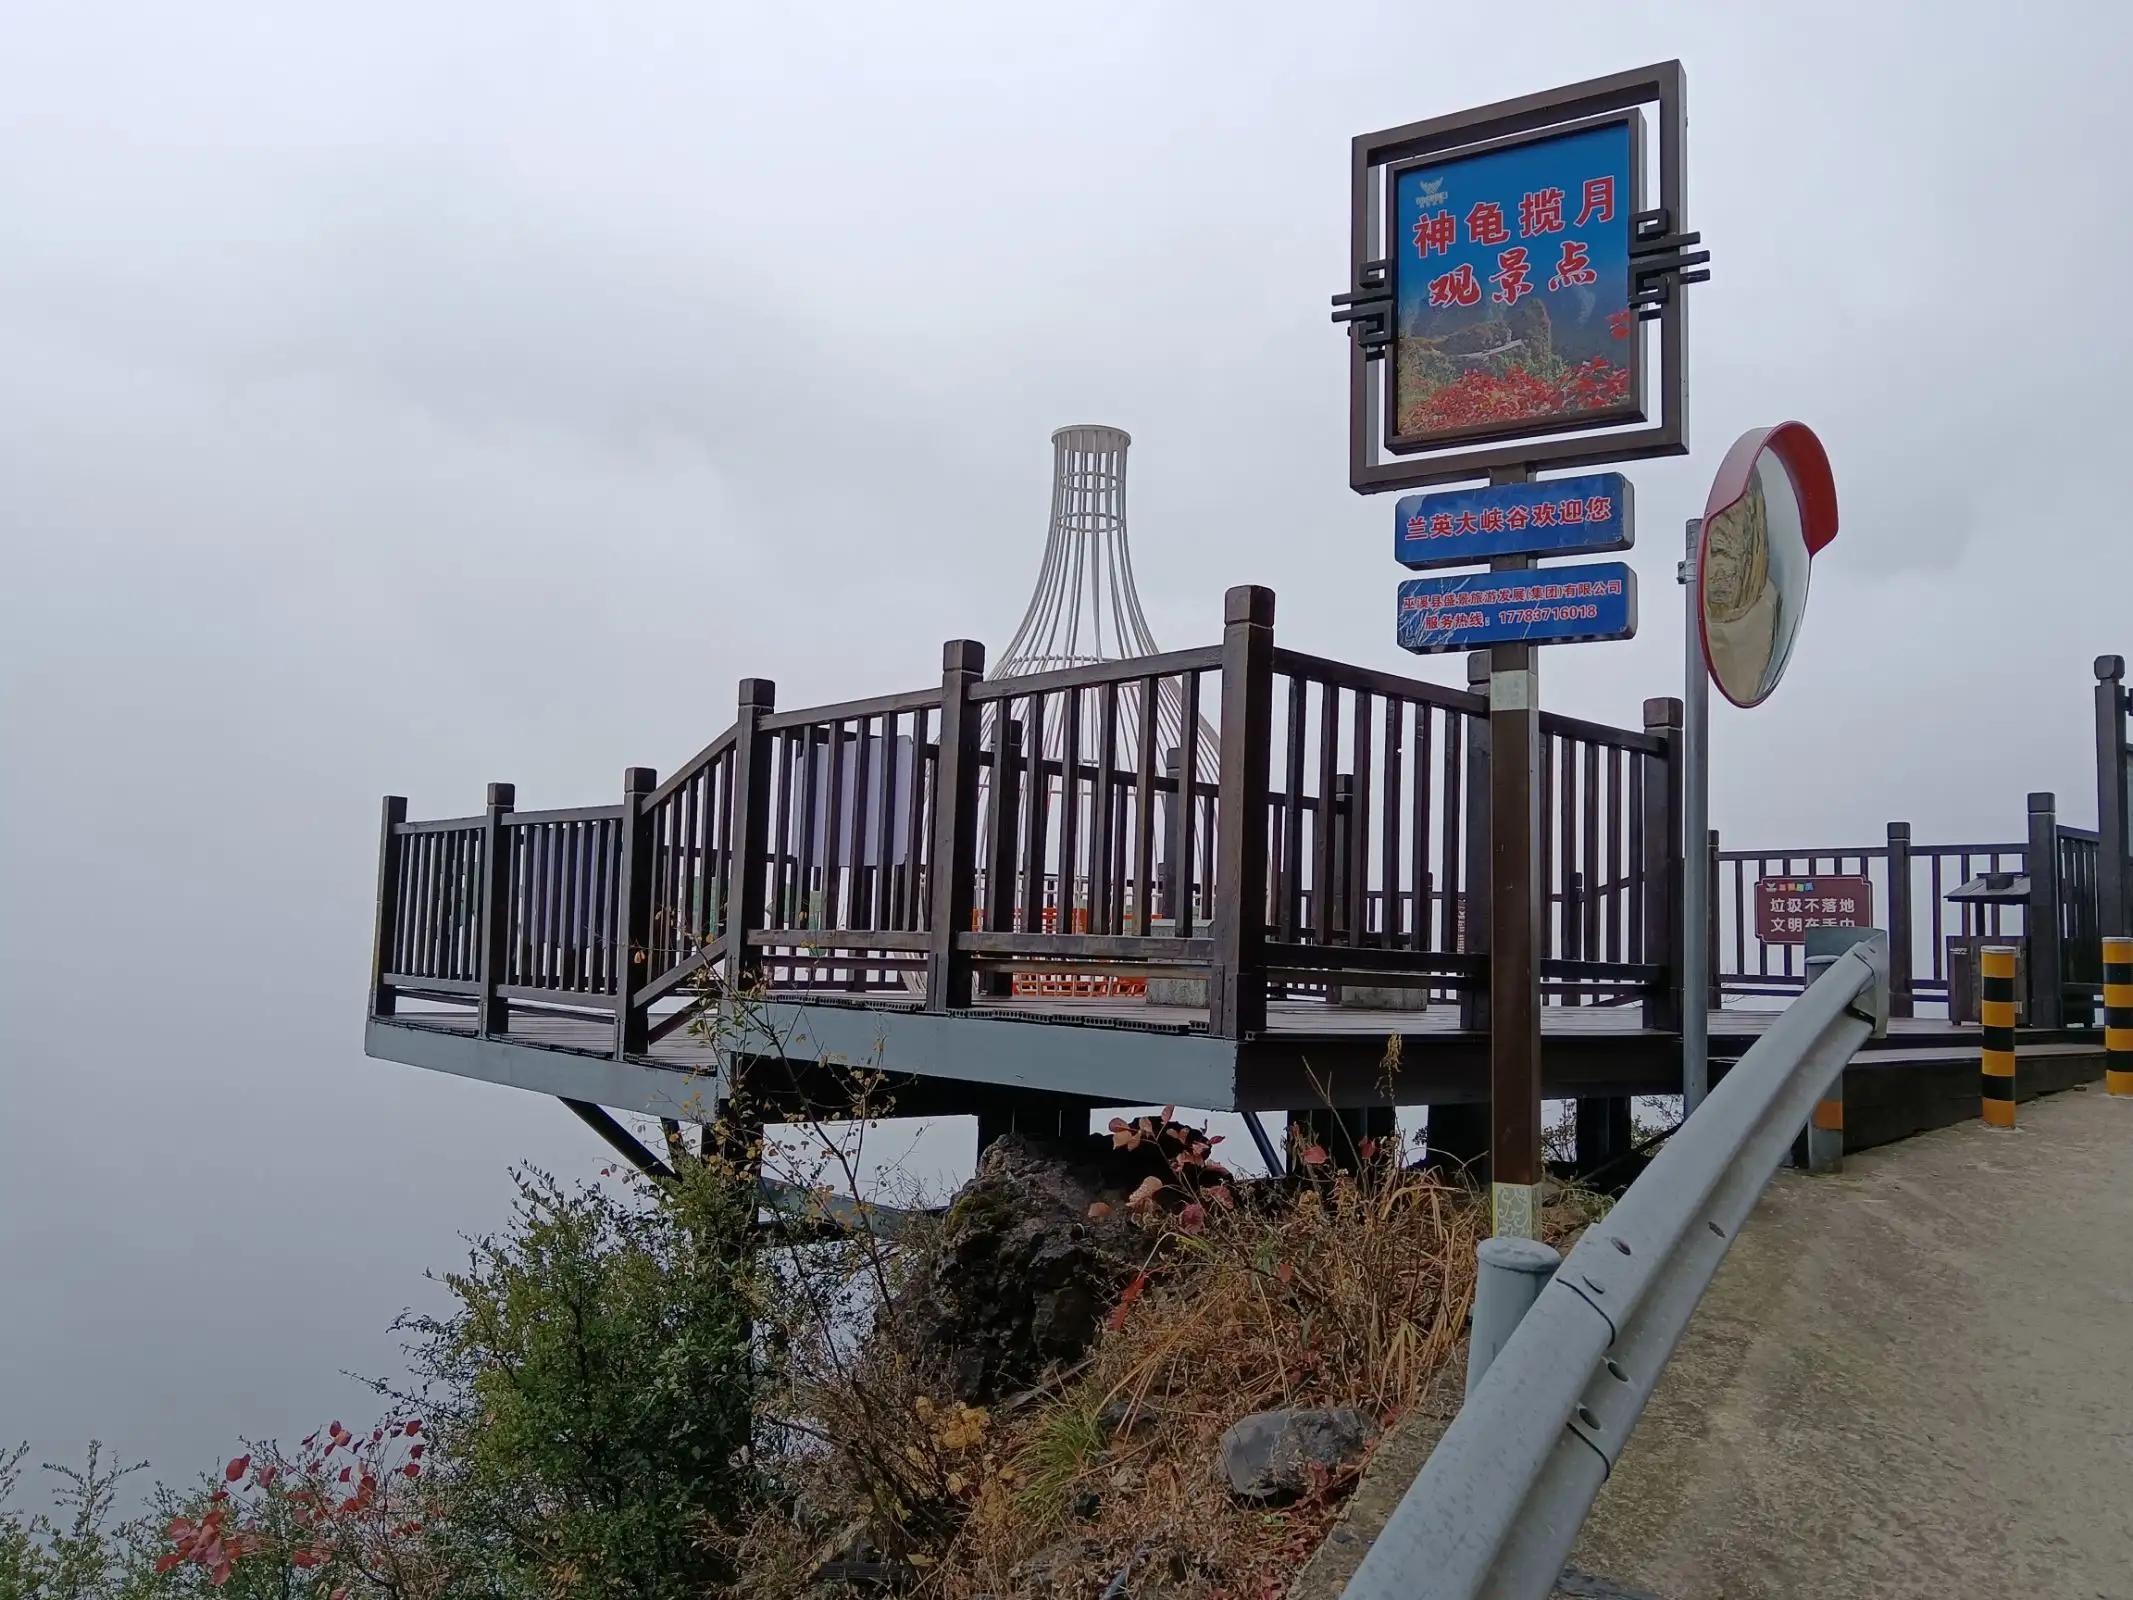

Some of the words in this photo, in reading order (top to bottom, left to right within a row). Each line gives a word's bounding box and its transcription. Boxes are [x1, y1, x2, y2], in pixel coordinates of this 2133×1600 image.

[1413, 176, 1615, 257] 神龟揽月
[1429, 241, 1596, 307] 观景点
[1405, 496, 1611, 540] 兰英大峡谷欢迎您
[1770, 898, 1855, 913] 垃圾不落地
